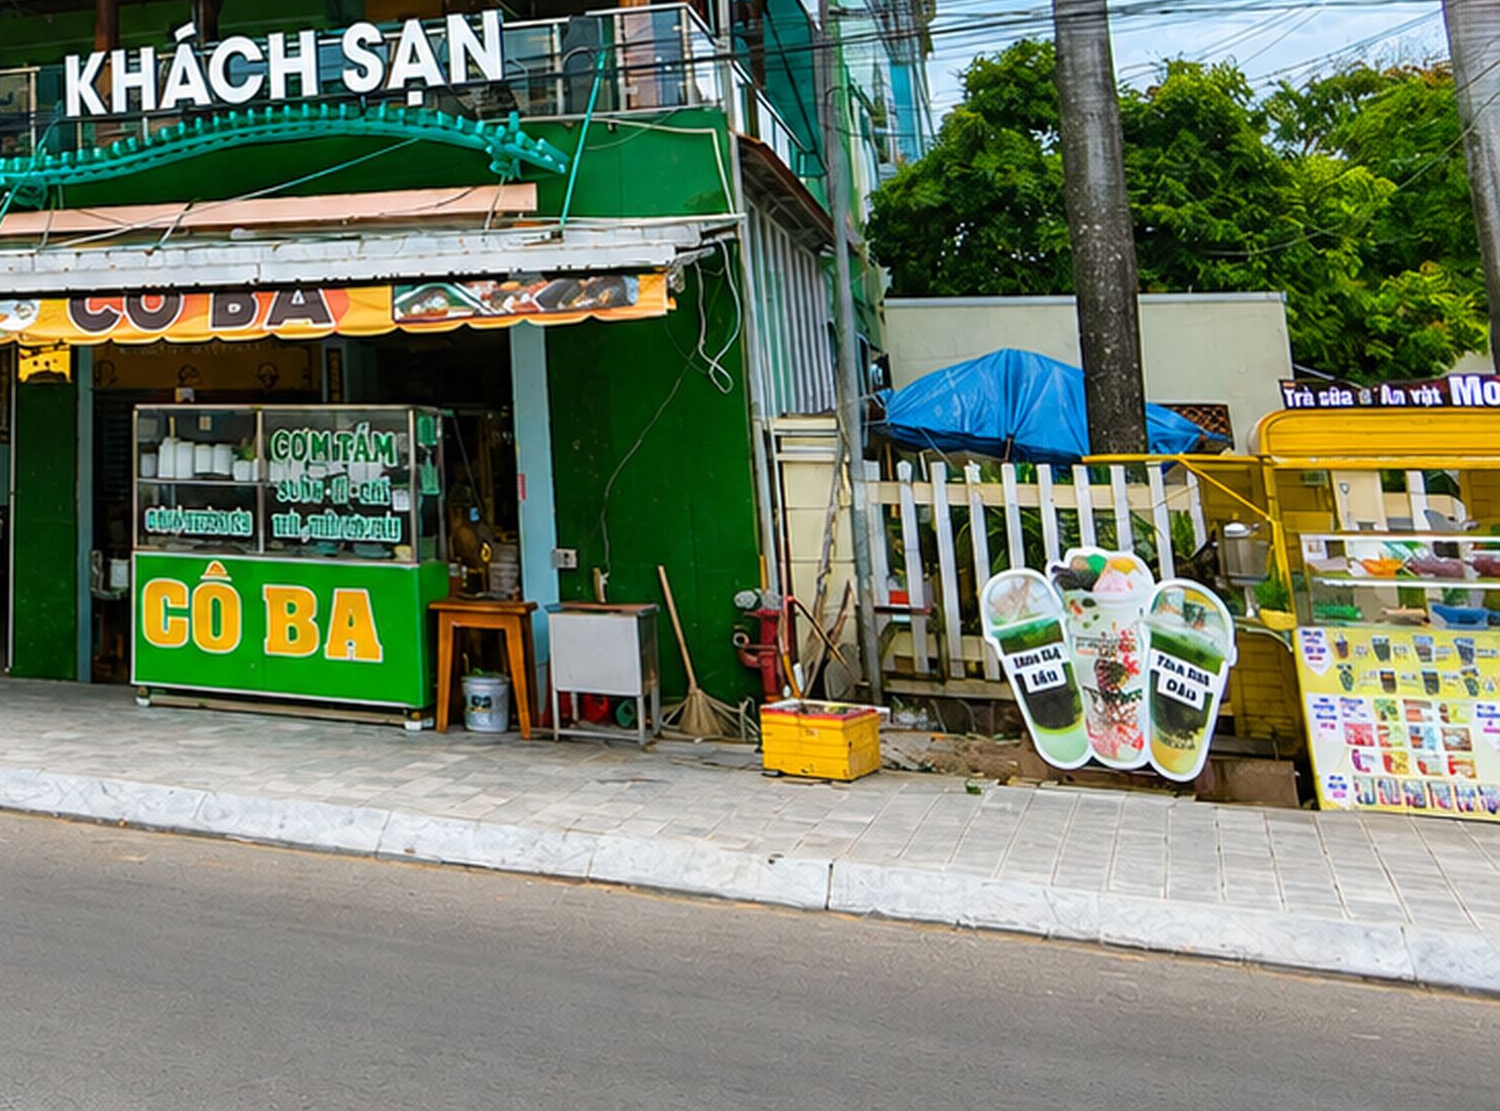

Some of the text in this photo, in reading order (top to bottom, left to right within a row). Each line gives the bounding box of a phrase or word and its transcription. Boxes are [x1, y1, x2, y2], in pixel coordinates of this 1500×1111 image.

[64, 8, 505, 118] KHÁCH SẠN
[142, 560, 384, 663] CÔ BA
